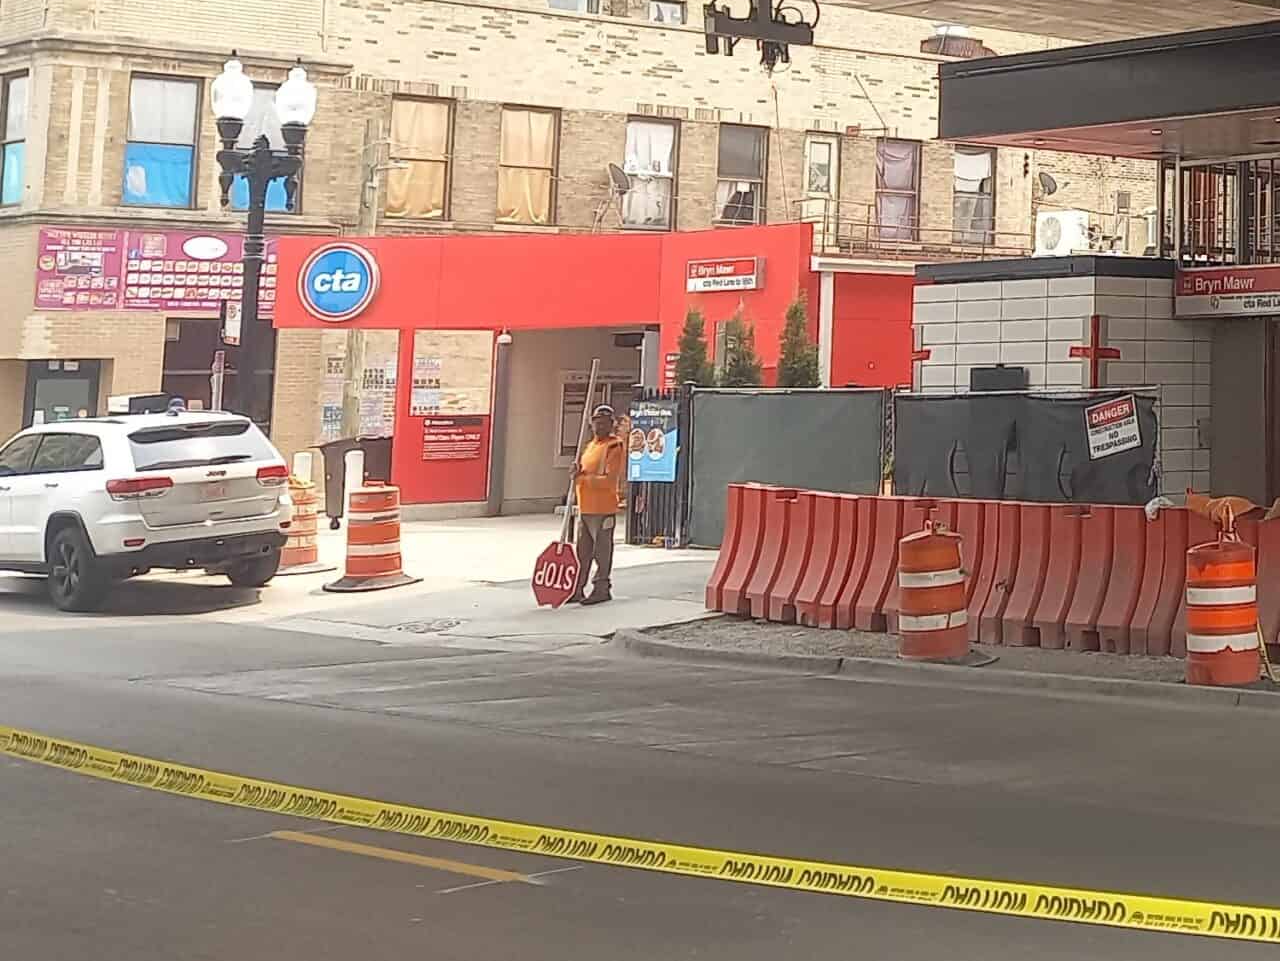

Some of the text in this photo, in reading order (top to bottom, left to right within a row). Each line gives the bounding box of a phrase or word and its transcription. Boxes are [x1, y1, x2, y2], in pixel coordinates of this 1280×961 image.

[697, 263, 715, 278] Bryn
[314, 269, 361, 293] cta
[1195, 276, 1255, 294] Bryn Mawr
[1243, 300, 1256, 309] cta
[1257, 299, 1272, 308] Red
[1092, 404, 1130, 423] DANGER
[1093, 434, 1138, 453] TRESPASSING
[1109, 430, 1119, 440] NO
[535, 561, 576, 590] STOP
